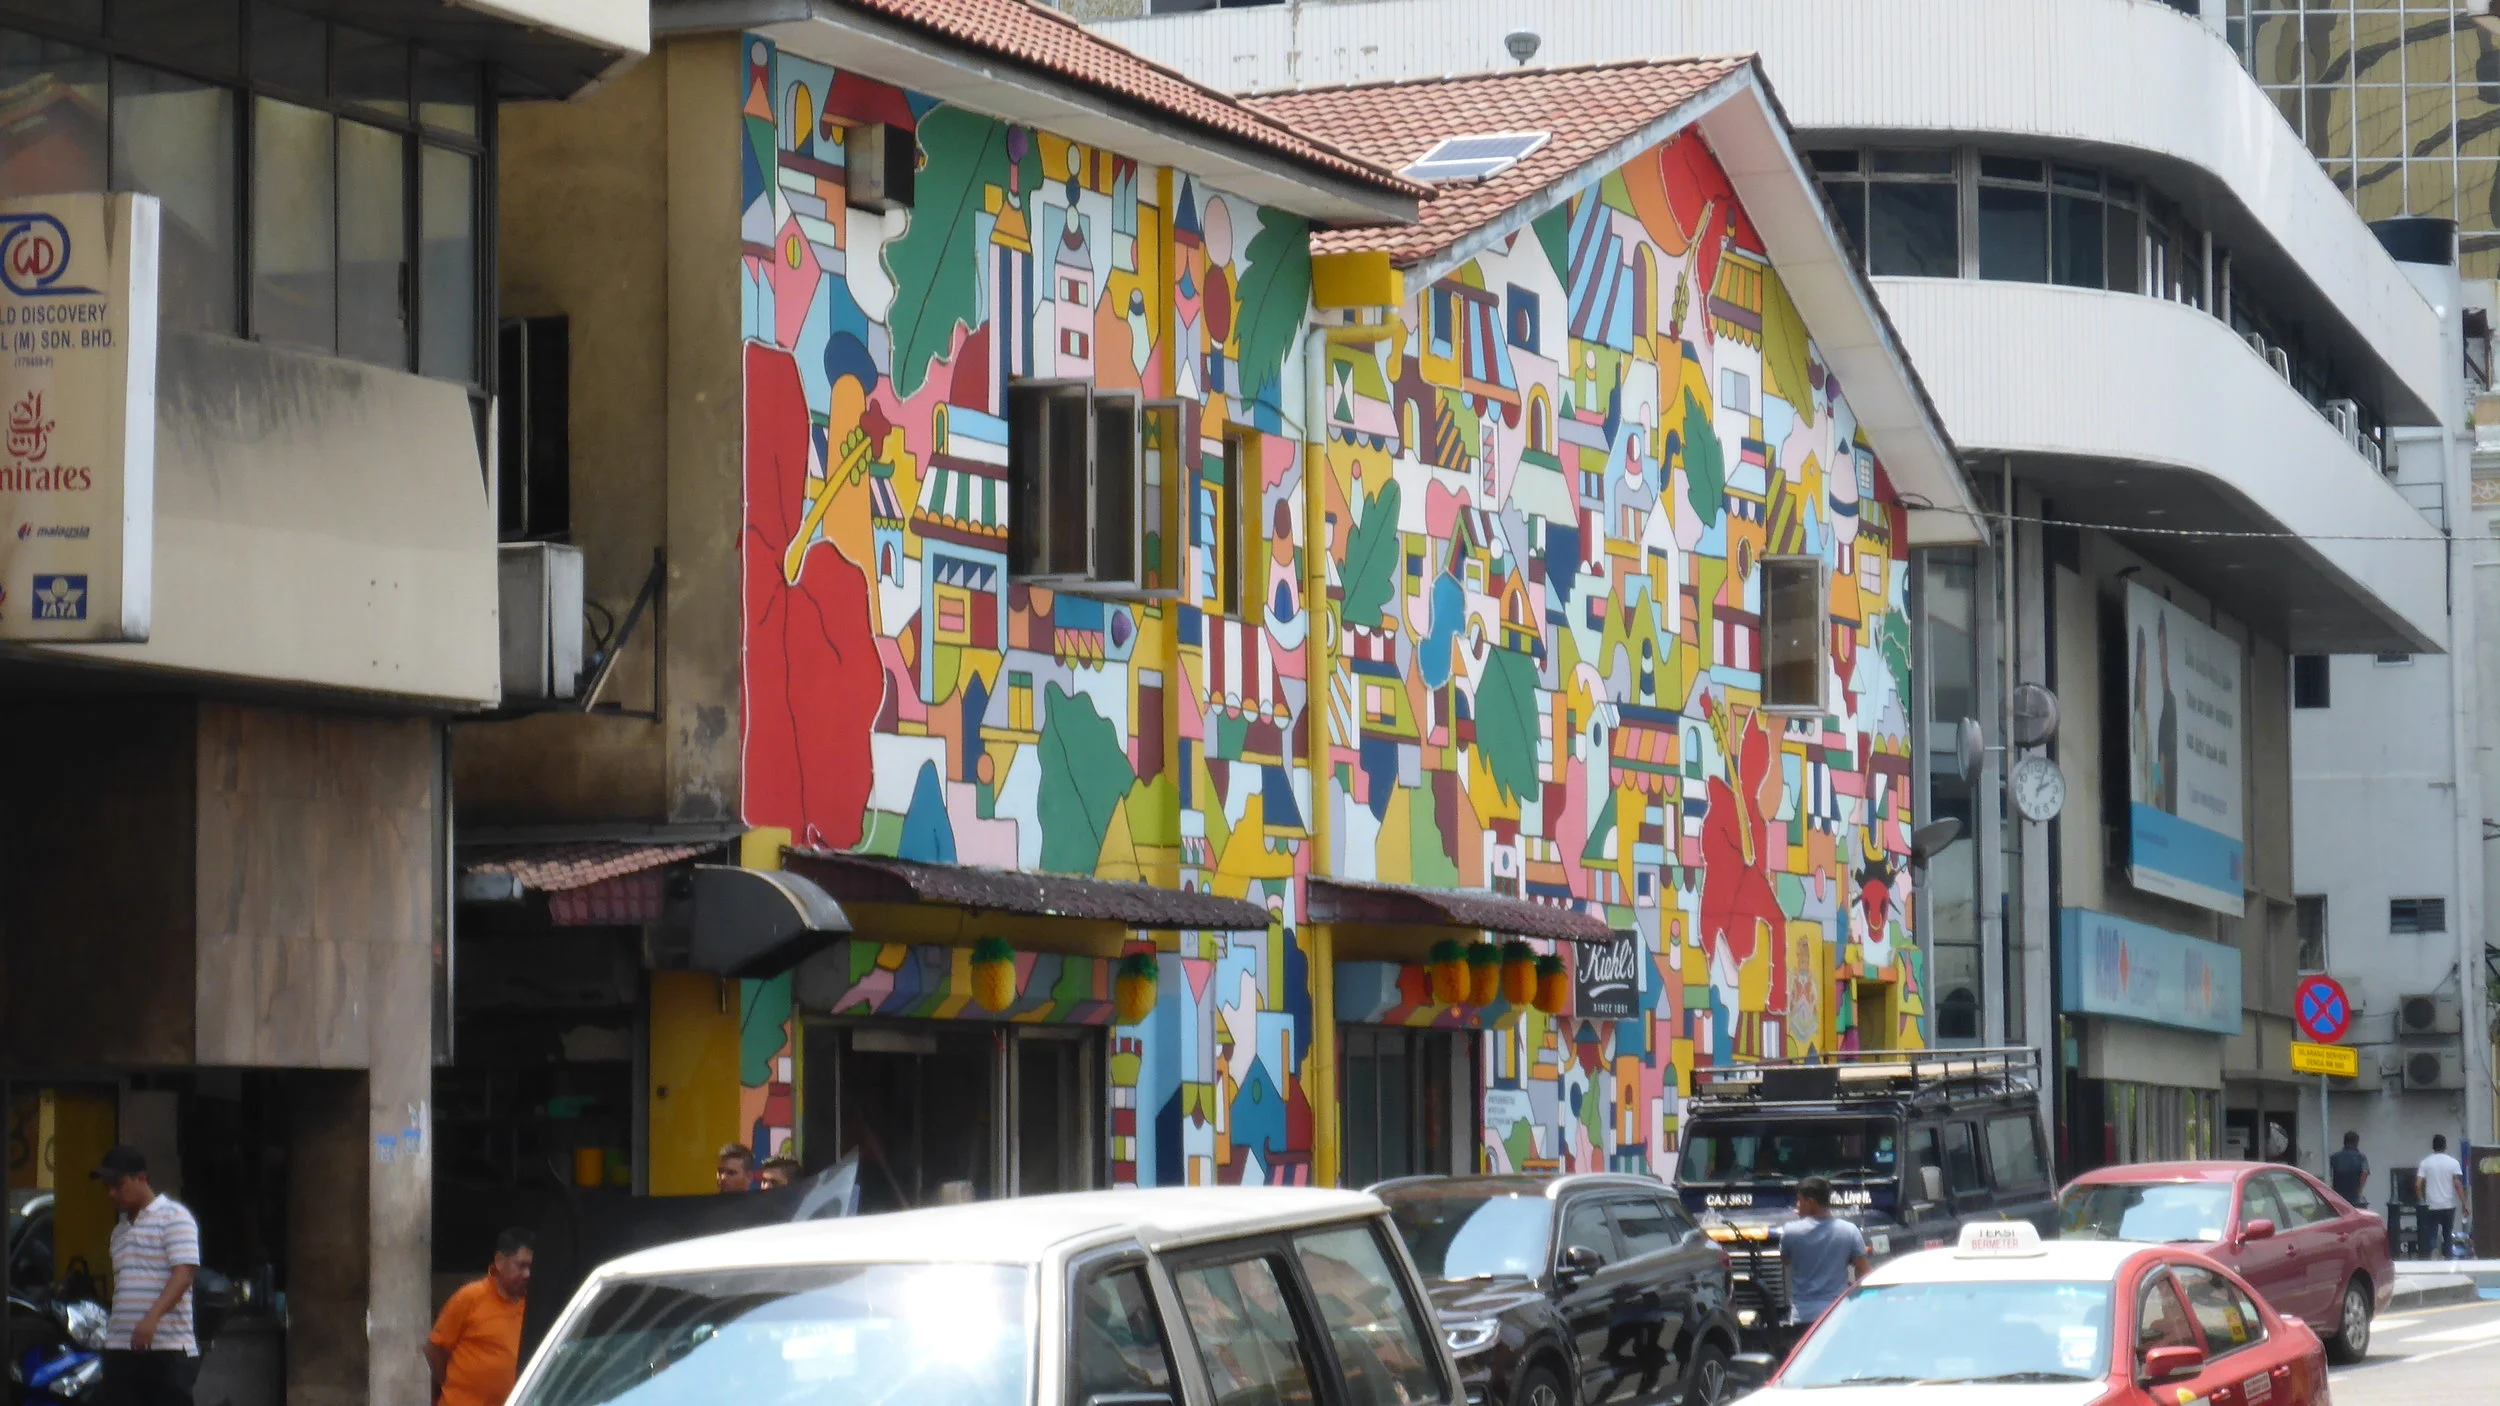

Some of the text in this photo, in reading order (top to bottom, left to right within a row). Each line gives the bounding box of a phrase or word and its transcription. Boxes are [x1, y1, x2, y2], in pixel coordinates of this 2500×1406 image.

[22, 303, 107, 325] DISCOVERY
[14, 331, 35, 353] (M)
[41, 330, 75, 349] SDN.
[81, 328, 116, 348] BHD.
[1580, 939, 1635, 983] Kiehl's
[1593, 1003, 1613, 1014] SINCE
[1979, 1228, 2015, 1238] TEKSI
[1972, 1239, 2019, 1250] BERMETER
